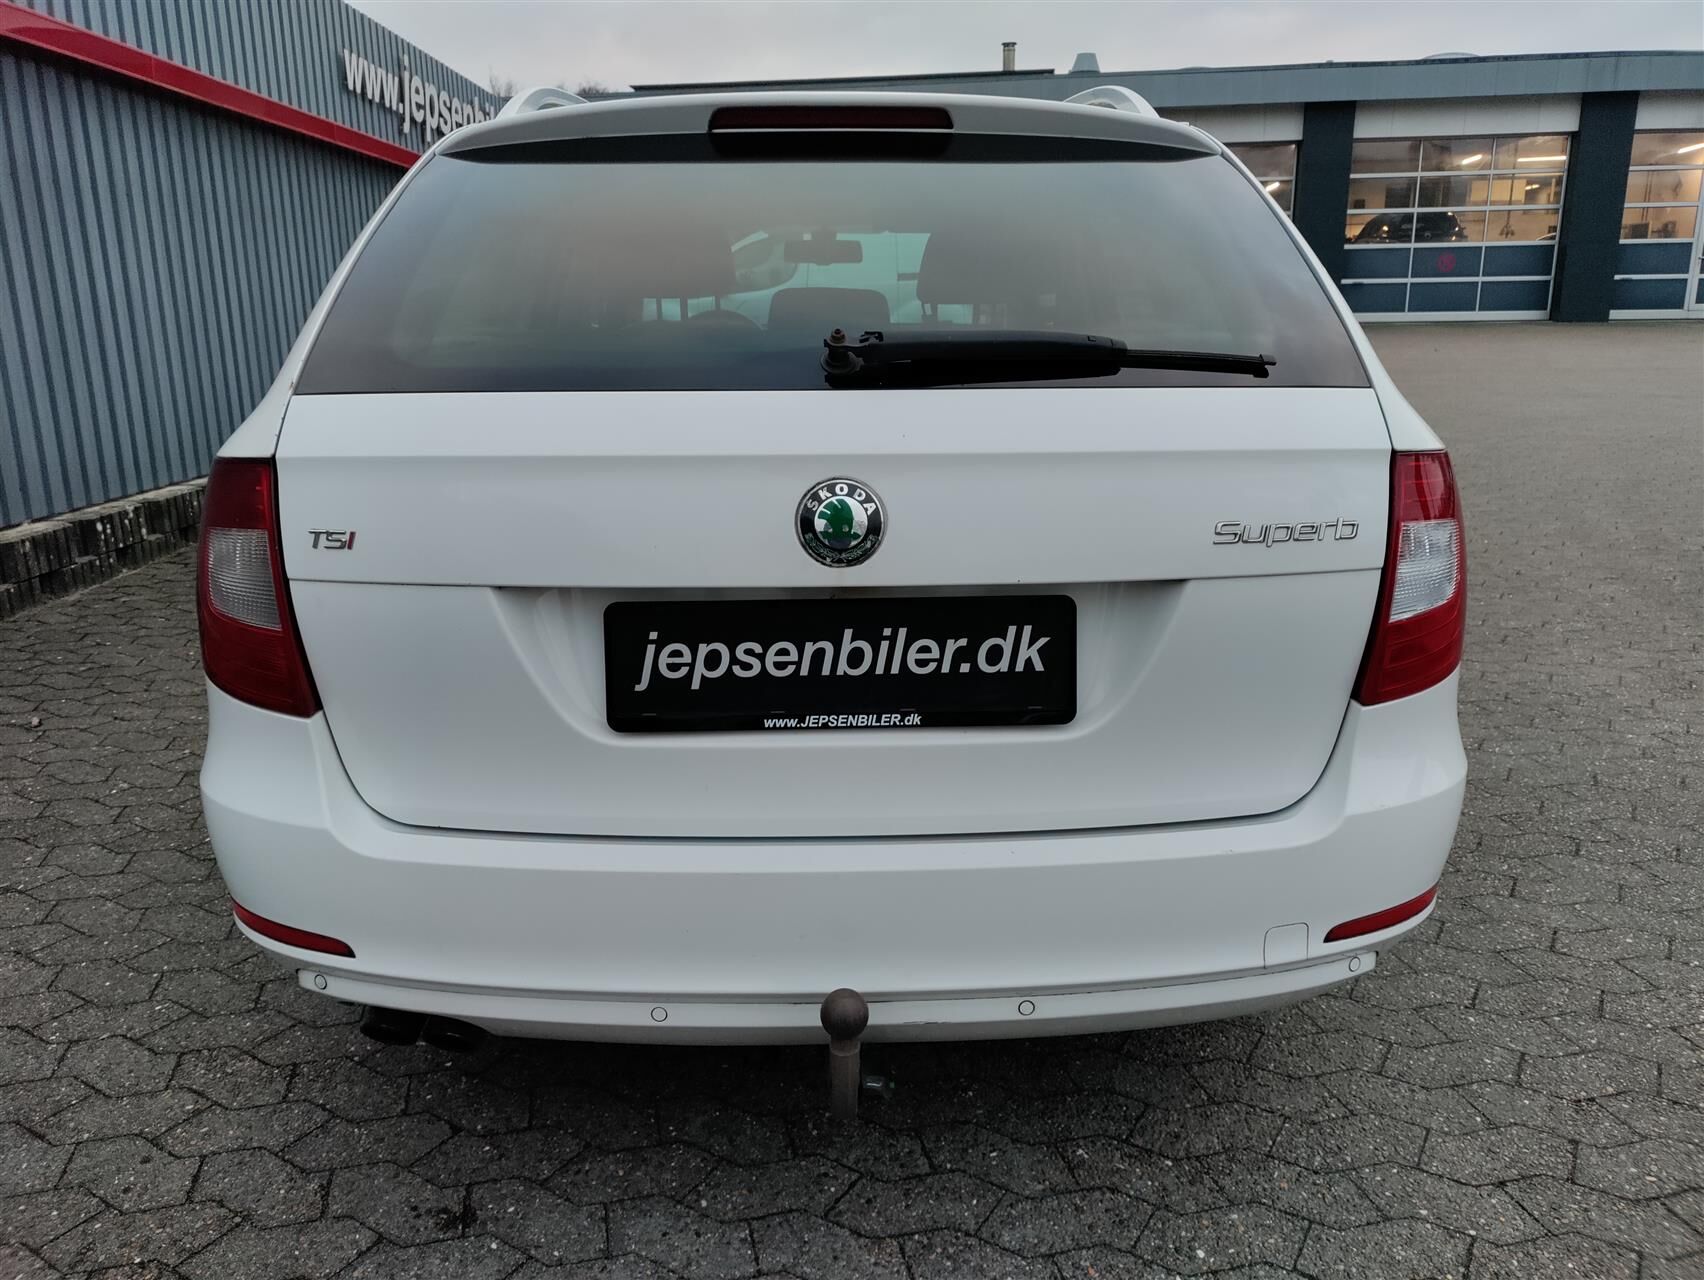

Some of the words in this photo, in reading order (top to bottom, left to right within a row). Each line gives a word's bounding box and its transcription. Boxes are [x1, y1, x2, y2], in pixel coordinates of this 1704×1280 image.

[343, 48, 496, 143] www.jepsen
[307, 528, 357, 551] TSI
[1212, 517, 1360, 548] Superb
[634, 624, 1052, 692] jepsenbiler.dk
[763, 713, 923, 728] www.JEPSENBILER.dk
